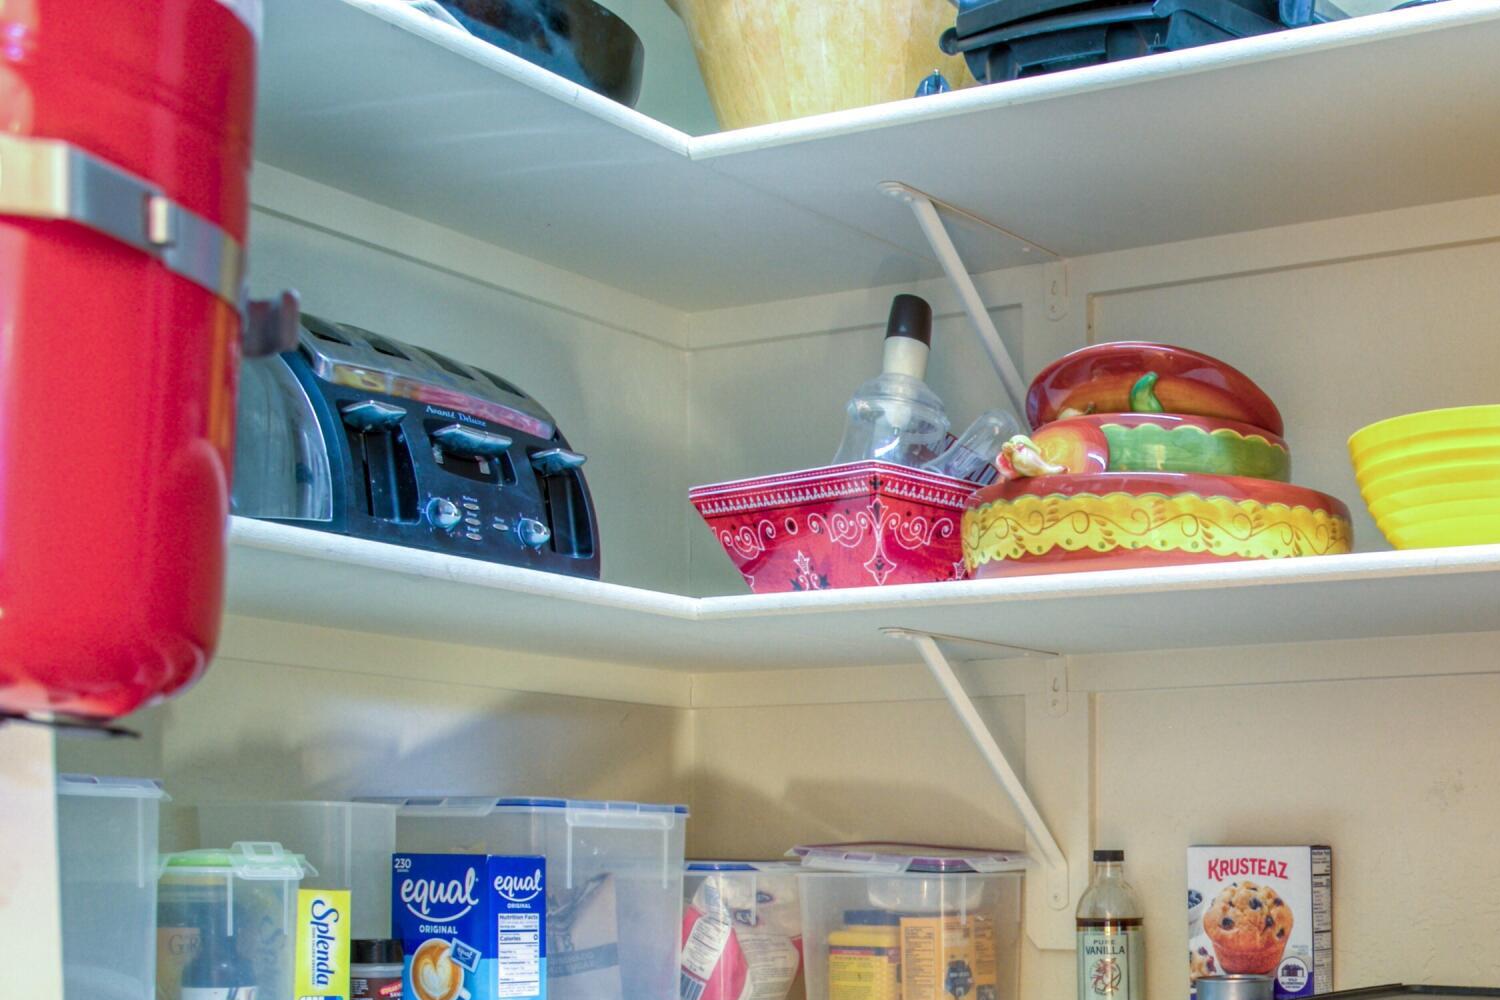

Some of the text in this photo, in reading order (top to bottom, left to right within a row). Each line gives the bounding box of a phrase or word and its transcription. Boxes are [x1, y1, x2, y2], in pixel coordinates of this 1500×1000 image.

[394, 858, 412, 869] 230
[1208, 858, 1289, 882] KRUSTEAZ
[401, 867, 479, 914] equal
[494, 868, 543, 897] equal
[419, 925, 458, 934] ORIGINAL
[311, 899, 339, 987] Splenda
